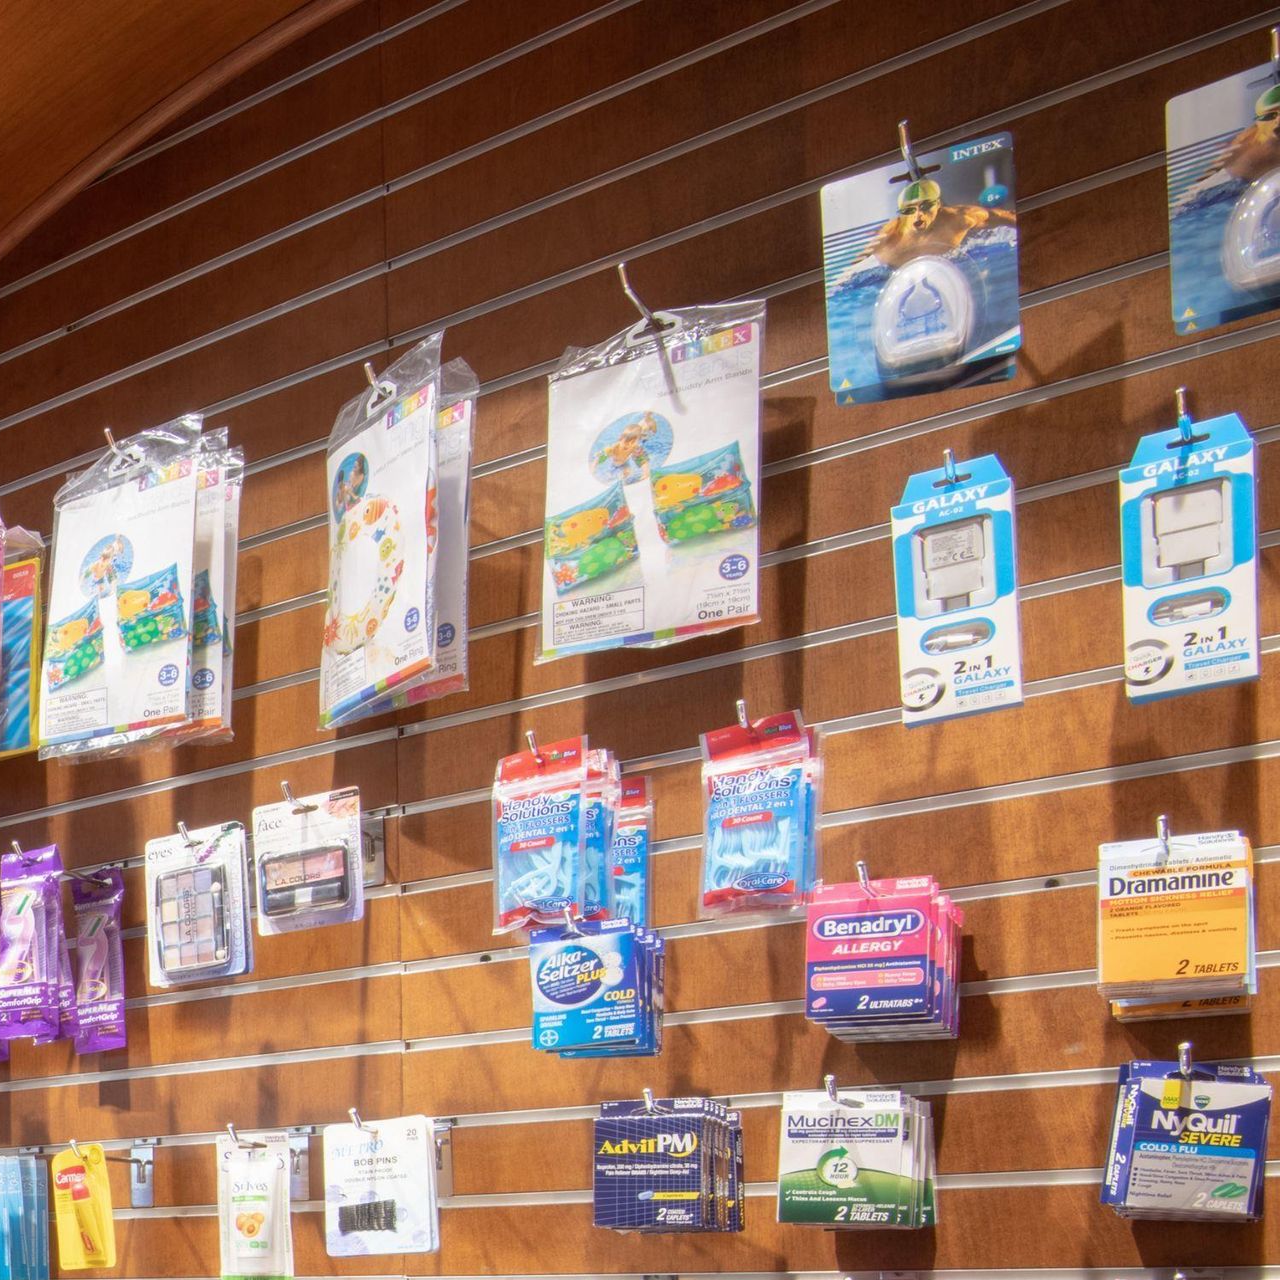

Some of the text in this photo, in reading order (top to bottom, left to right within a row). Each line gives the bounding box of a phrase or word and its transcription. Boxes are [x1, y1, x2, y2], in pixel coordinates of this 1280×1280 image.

[952, 139, 1004, 161] INTEX
[1143, 447, 1229, 478] GALAXY
[912, 486, 988, 514] GALAXY
[698, 604, 750, 620] One Pair
[1183, 631, 1198, 646] 2
[1183, 637, 1247, 657] GALAXY
[954, 665, 1011, 684] GALAXY
[148, 848, 173, 861] eyes
[1110, 871, 1234, 896] Dramamine
[824, 914, 912, 936] Benadryl
[832, 940, 903, 955] ALLERGY
[539, 959, 598, 985] Seltzer
[1176, 959, 1239, 975] 2 TABLETS
[604, 989, 635, 1001] COLD
[857, 995, 869, 1009] 2
[592, 1025, 603, 1039] 2
[1151, 1110, 1237, 1136] NyQuil
[598, 1132, 693, 1155] Advil PM
[1179, 1132, 1243, 1147] SEVERE
[1140, 1143, 1169, 1152] COLD
[1179, 1146, 1198, 1154] FLU
[376, 1156, 398, 1165] PINS
[832, 1163, 848, 1174] 12
[1193, 1192, 1207, 1208] 2
[835, 1206, 847, 1222] 2
